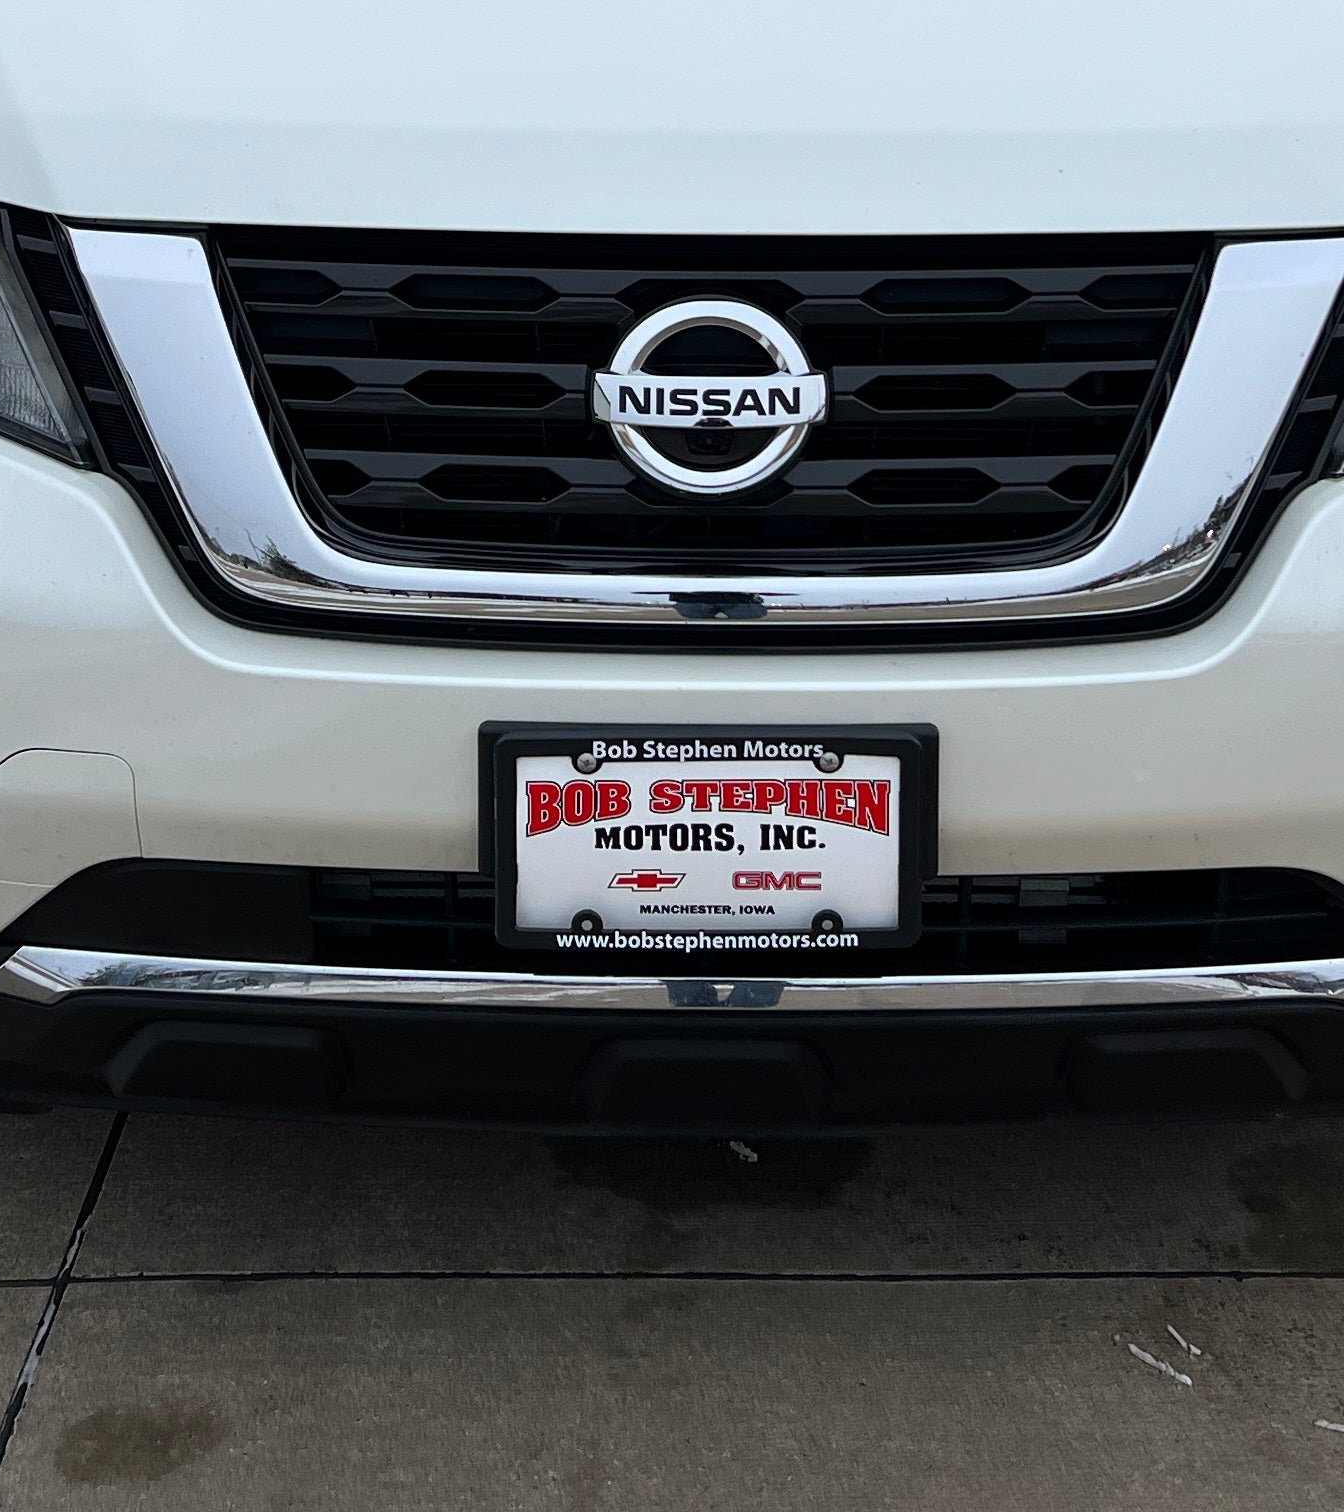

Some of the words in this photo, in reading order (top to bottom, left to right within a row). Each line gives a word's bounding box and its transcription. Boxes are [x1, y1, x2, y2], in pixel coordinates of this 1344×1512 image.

[619, 385, 801, 417] NISSAN
[592, 740, 637, 759] Bob
[643, 740, 737, 763] Stephen
[743, 740, 824, 758] Motors
[526, 780, 631, 837] BOB
[649, 778, 891, 836] STEPHEN
[594, 823, 745, 856] MOTORS,
[760, 824, 826, 851] INC.
[732, 870, 822, 891] GMC
[639, 904, 736, 916] MANCHESTER,
[739, 905, 775, 915] IOWA
[556, 929, 859, 953] www.bobstephenmotors.com
